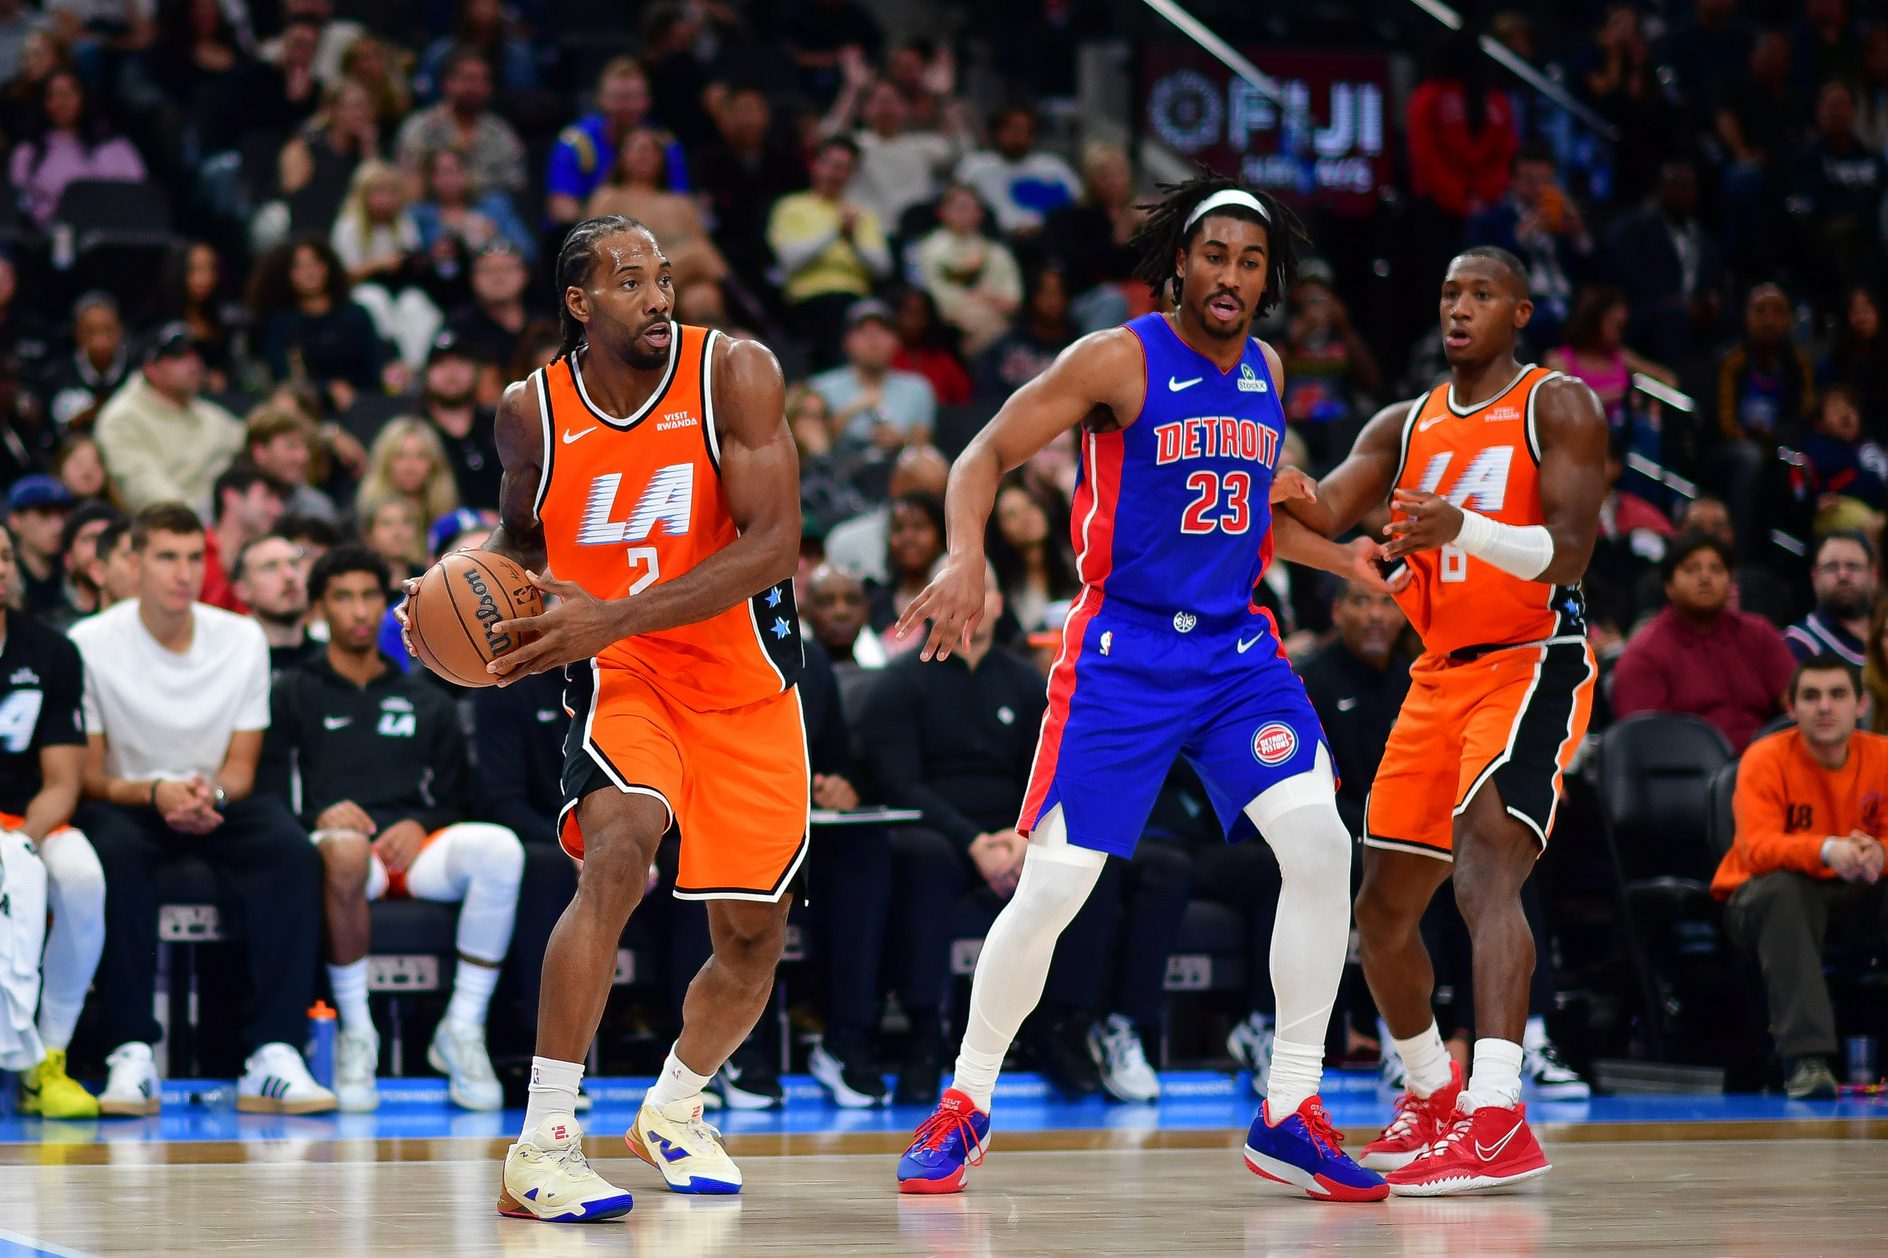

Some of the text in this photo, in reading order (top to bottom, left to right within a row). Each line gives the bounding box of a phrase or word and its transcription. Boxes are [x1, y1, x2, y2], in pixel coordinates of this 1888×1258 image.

[1238, 380, 1266, 390] StockX
[656, 418, 698, 431] RWANDA
[664, 411, 688, 421] VISIT
[1153, 415, 1279, 470] DETROIT
[575, 462, 694, 547] LA
[1180, 470, 1251, 535] 23
[627, 546, 660, 597] 2
